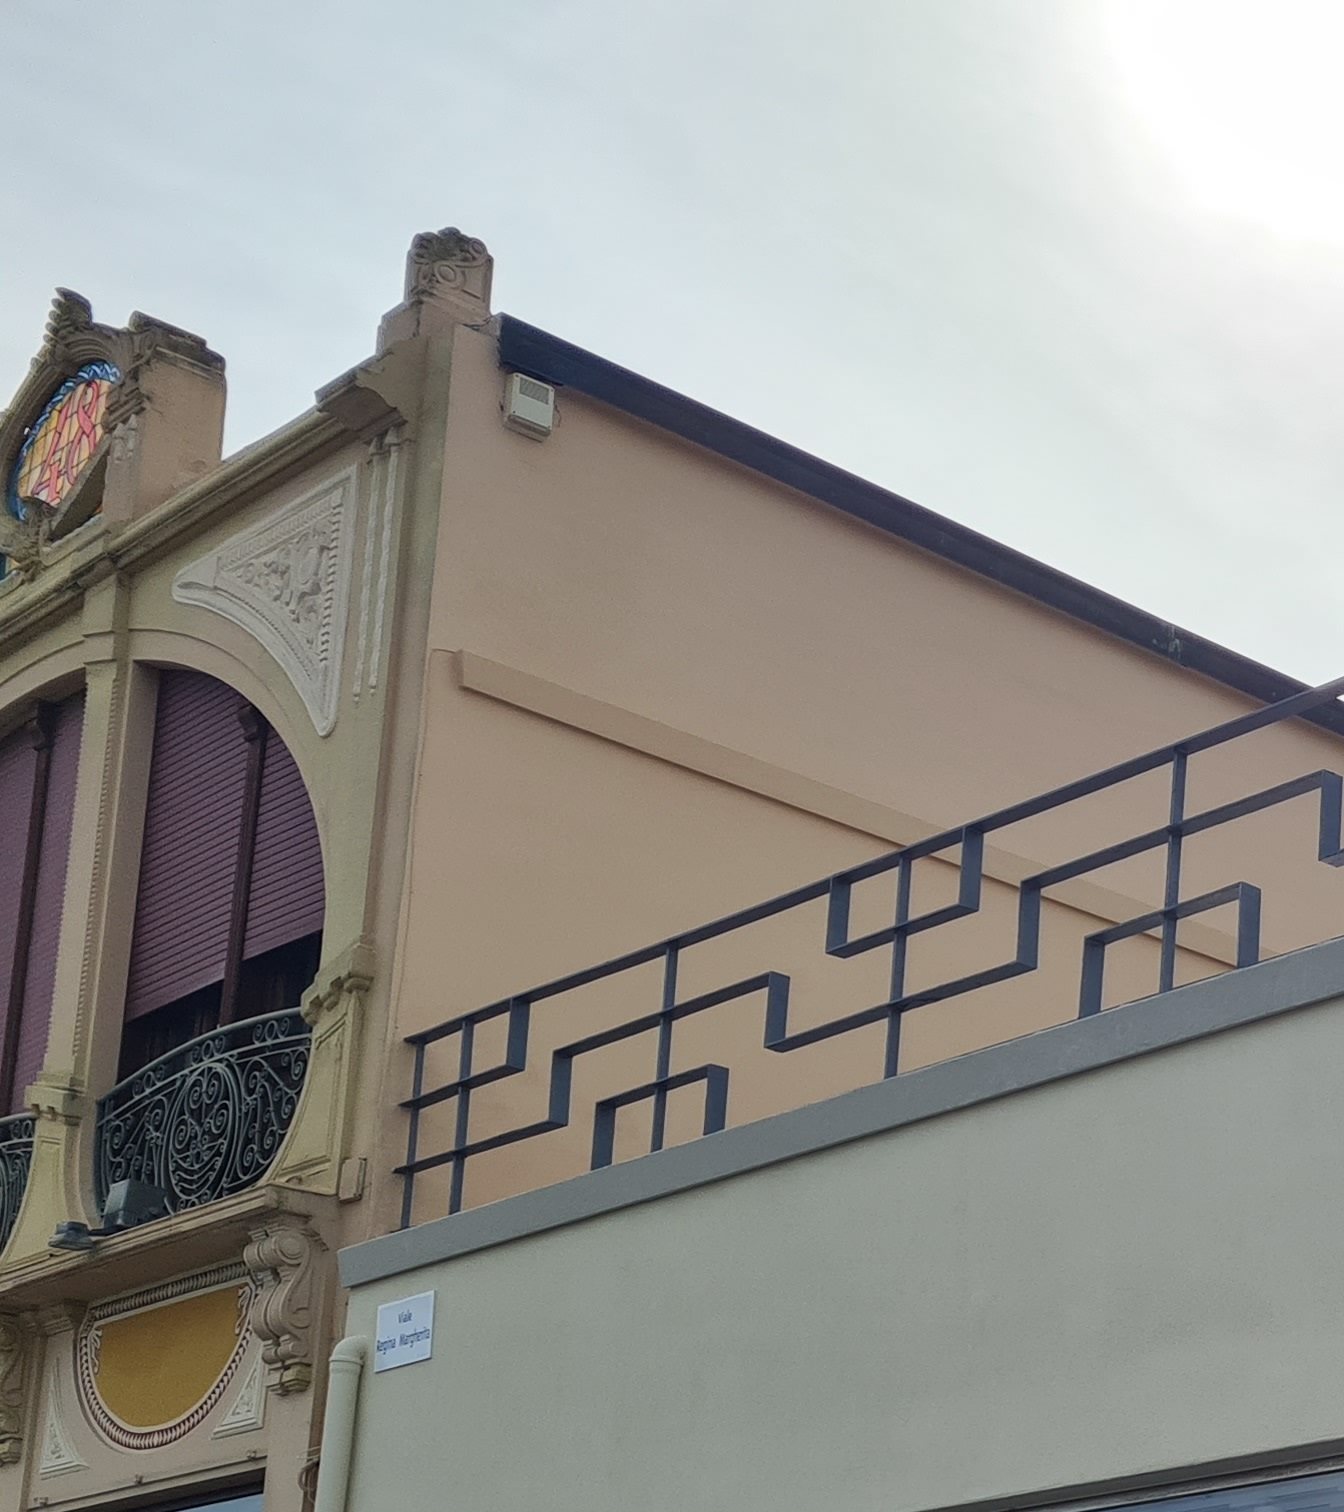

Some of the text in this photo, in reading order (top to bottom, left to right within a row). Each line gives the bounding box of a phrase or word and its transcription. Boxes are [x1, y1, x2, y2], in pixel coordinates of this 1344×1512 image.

[398, 1310, 413, 1324] Viale
[376, 1327, 431, 1356] Regina Margherita
